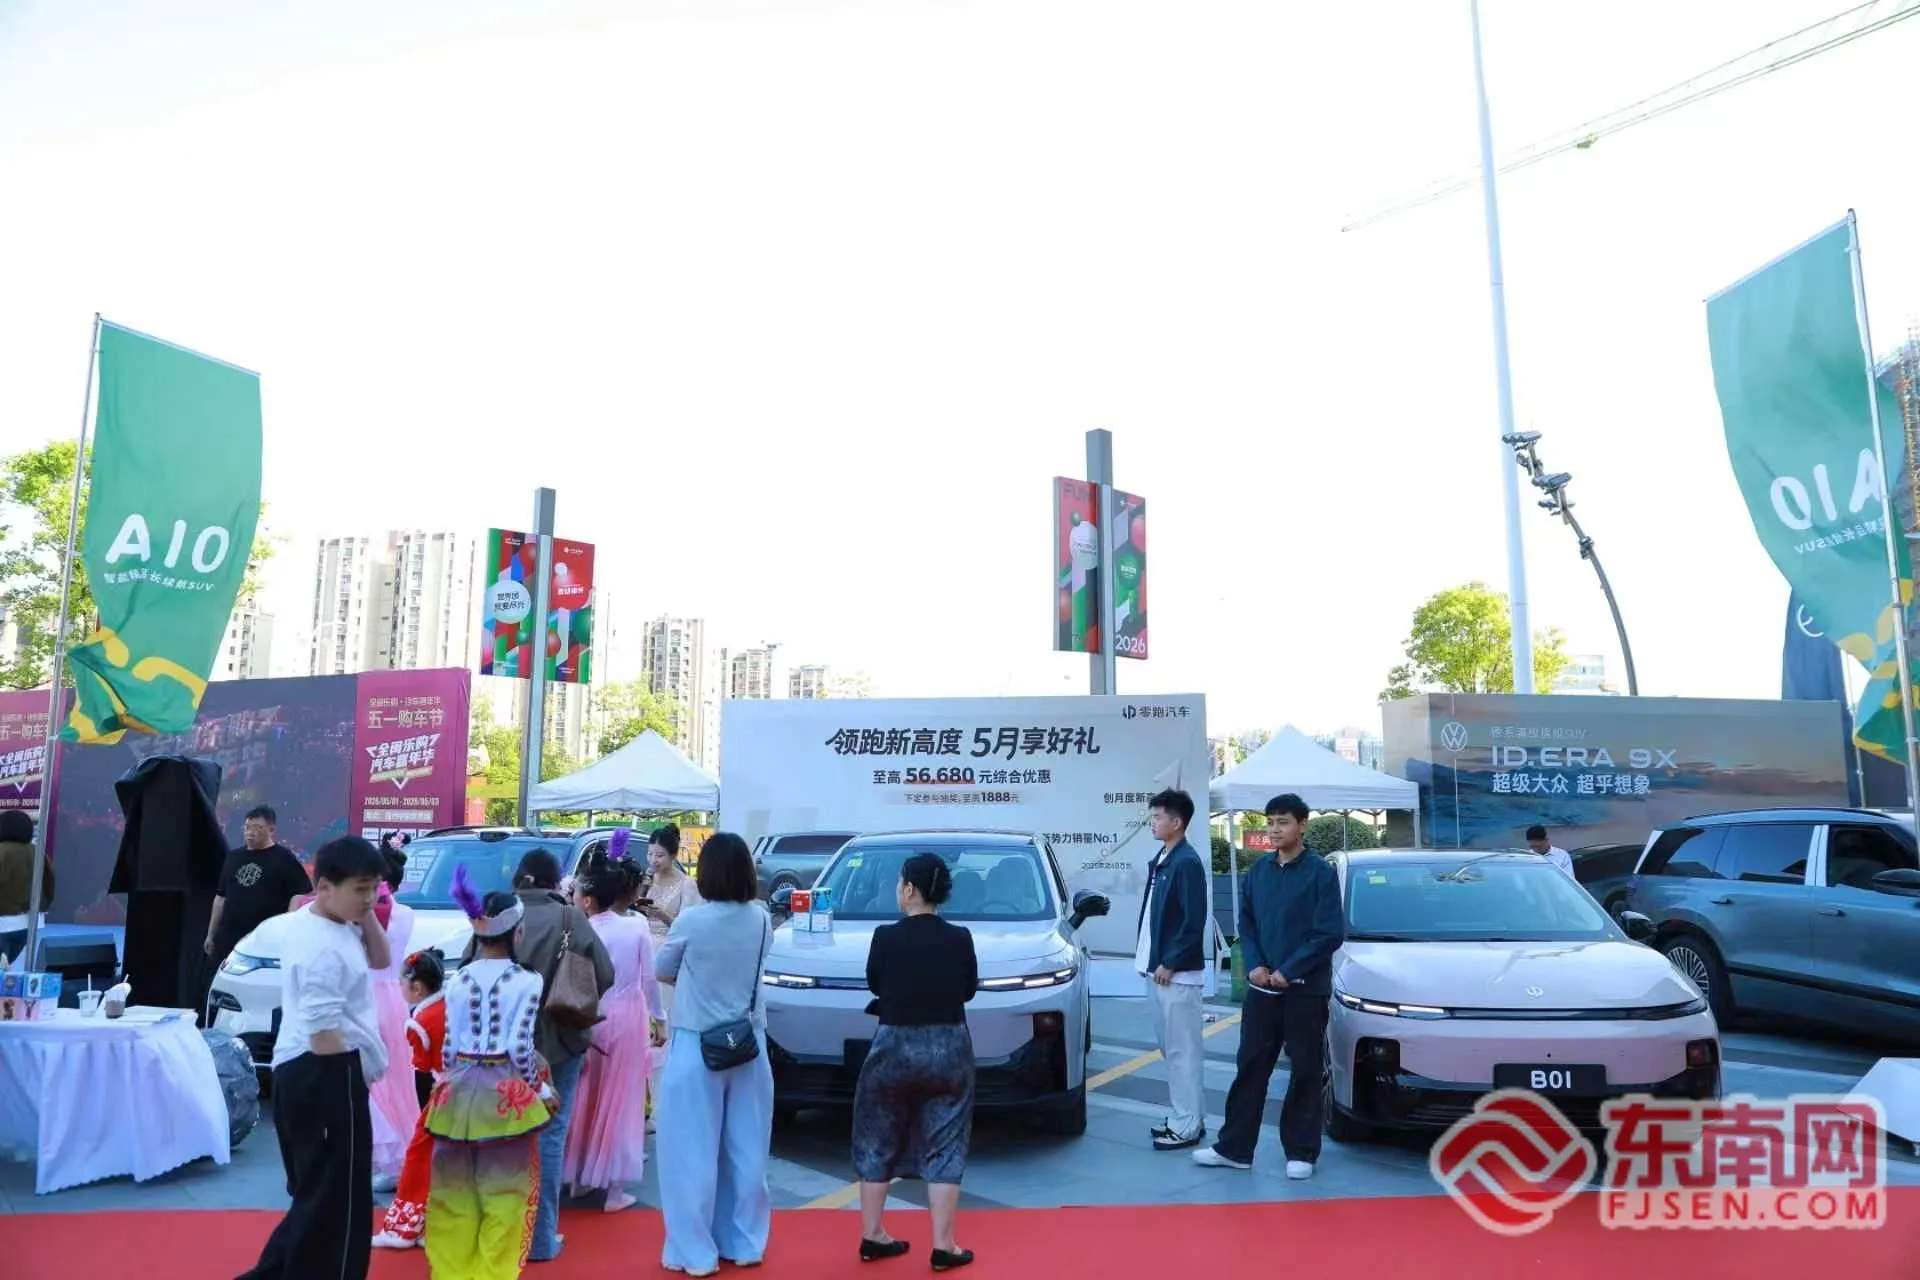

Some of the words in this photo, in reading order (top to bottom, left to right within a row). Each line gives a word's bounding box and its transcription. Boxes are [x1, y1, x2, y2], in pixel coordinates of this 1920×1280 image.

[1115, 634, 1146, 653] 2026
[368, 709, 444, 729] 五一购车节
[1139, 706, 1190, 718] 零跑汽车
[825, 728, 963, 756] 领跑新高度
[970, 727, 1100, 760] 5月享好礼
[1491, 746, 1615, 767] ID.ERA
[1629, 749, 1677, 769] 9X
[873, 770, 900, 784] 至高
[979, 769, 1051, 784] 元综合优惠
[1492, 774, 1568, 793] 超级大众
[1577, 775, 1650, 794] 超乎想象
